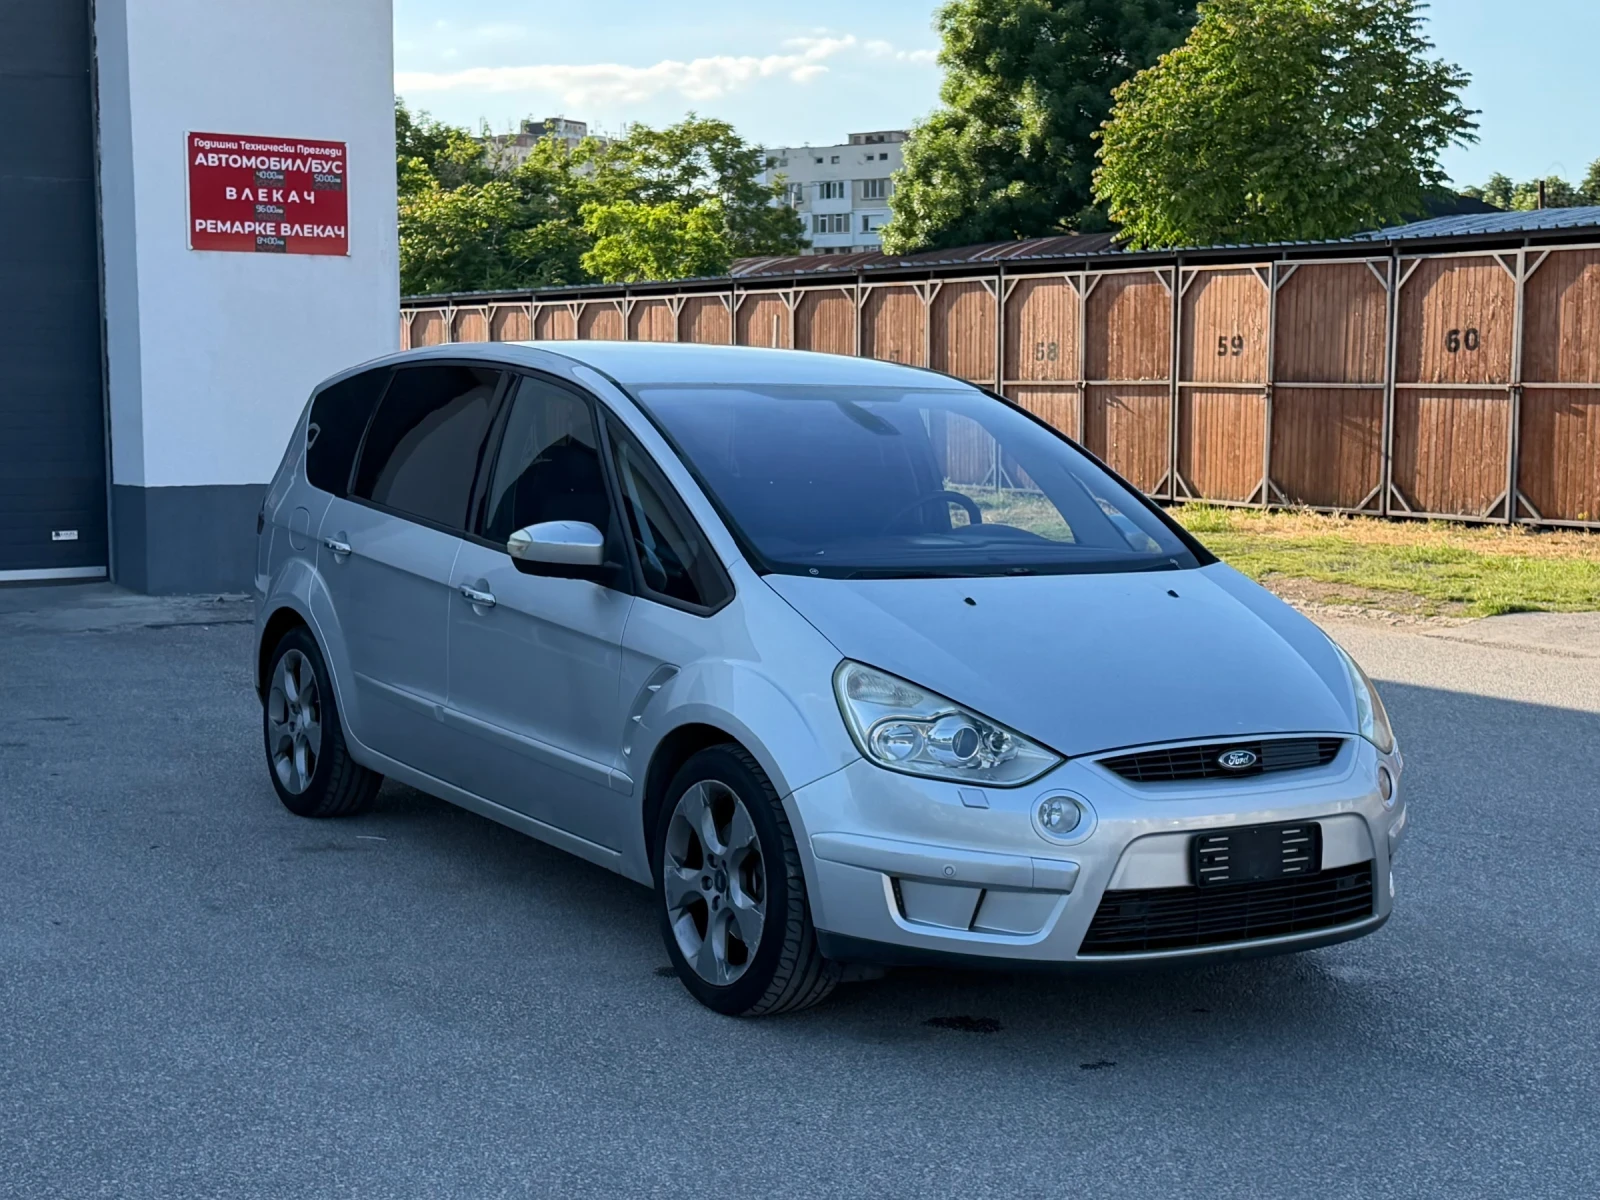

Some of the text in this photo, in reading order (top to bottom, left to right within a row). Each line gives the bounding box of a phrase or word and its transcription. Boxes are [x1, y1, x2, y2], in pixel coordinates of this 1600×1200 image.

[194, 138, 342, 157] Годишни Технически Прегледи
[195, 153, 343, 173] АВТОМОБИЛ/БУС
[225, 187, 315, 204] ВЛЕКАЧ
[195, 219, 345, 238] РЕМАРКЕ ВЛЕКАЧ
[1217, 335, 1244, 357] 59
[1445, 328, 1480, 353] 60
[1035, 342, 1058, 361] 58
[1228, 752, 1249, 766] Ford
